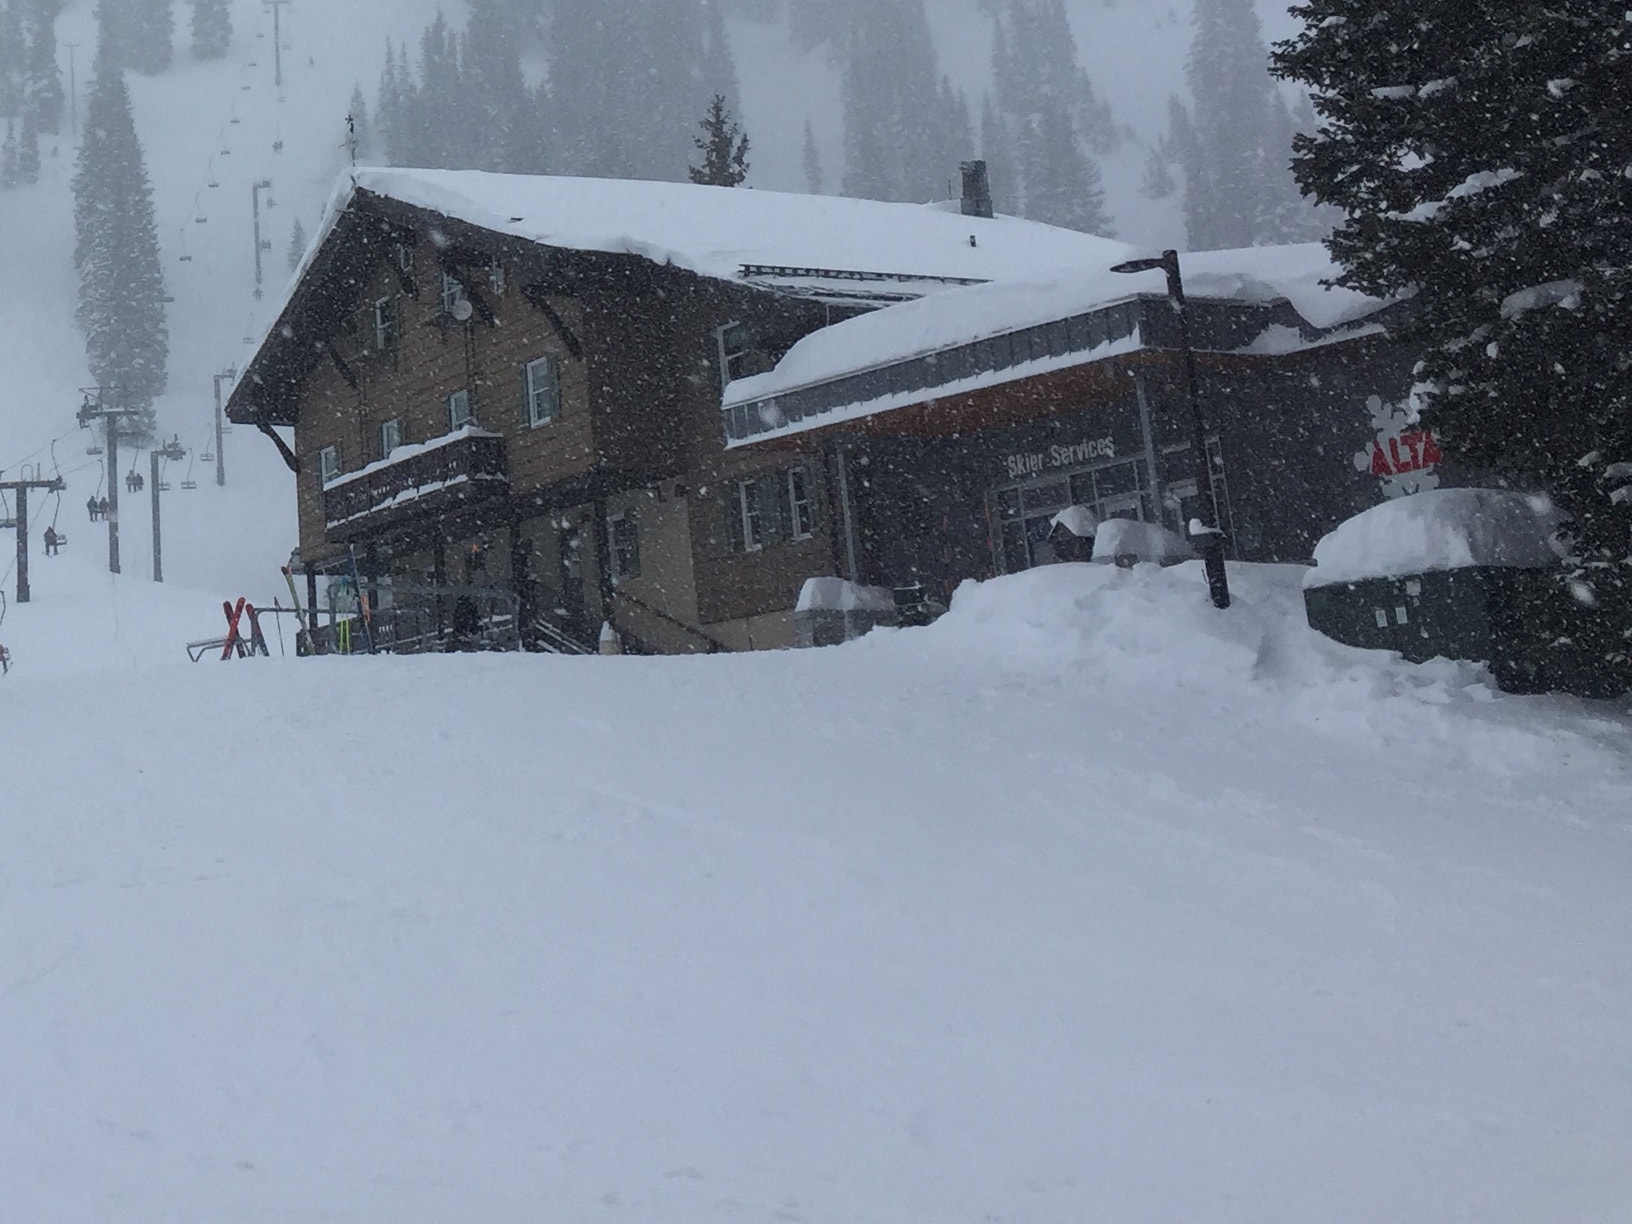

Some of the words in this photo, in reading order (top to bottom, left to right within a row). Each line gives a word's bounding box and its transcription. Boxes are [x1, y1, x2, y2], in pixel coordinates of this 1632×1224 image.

[1007, 454, 1044, 478] Skier
[1050, 436, 1115, 466] Services
[1372, 431, 1443, 476] ALTA
